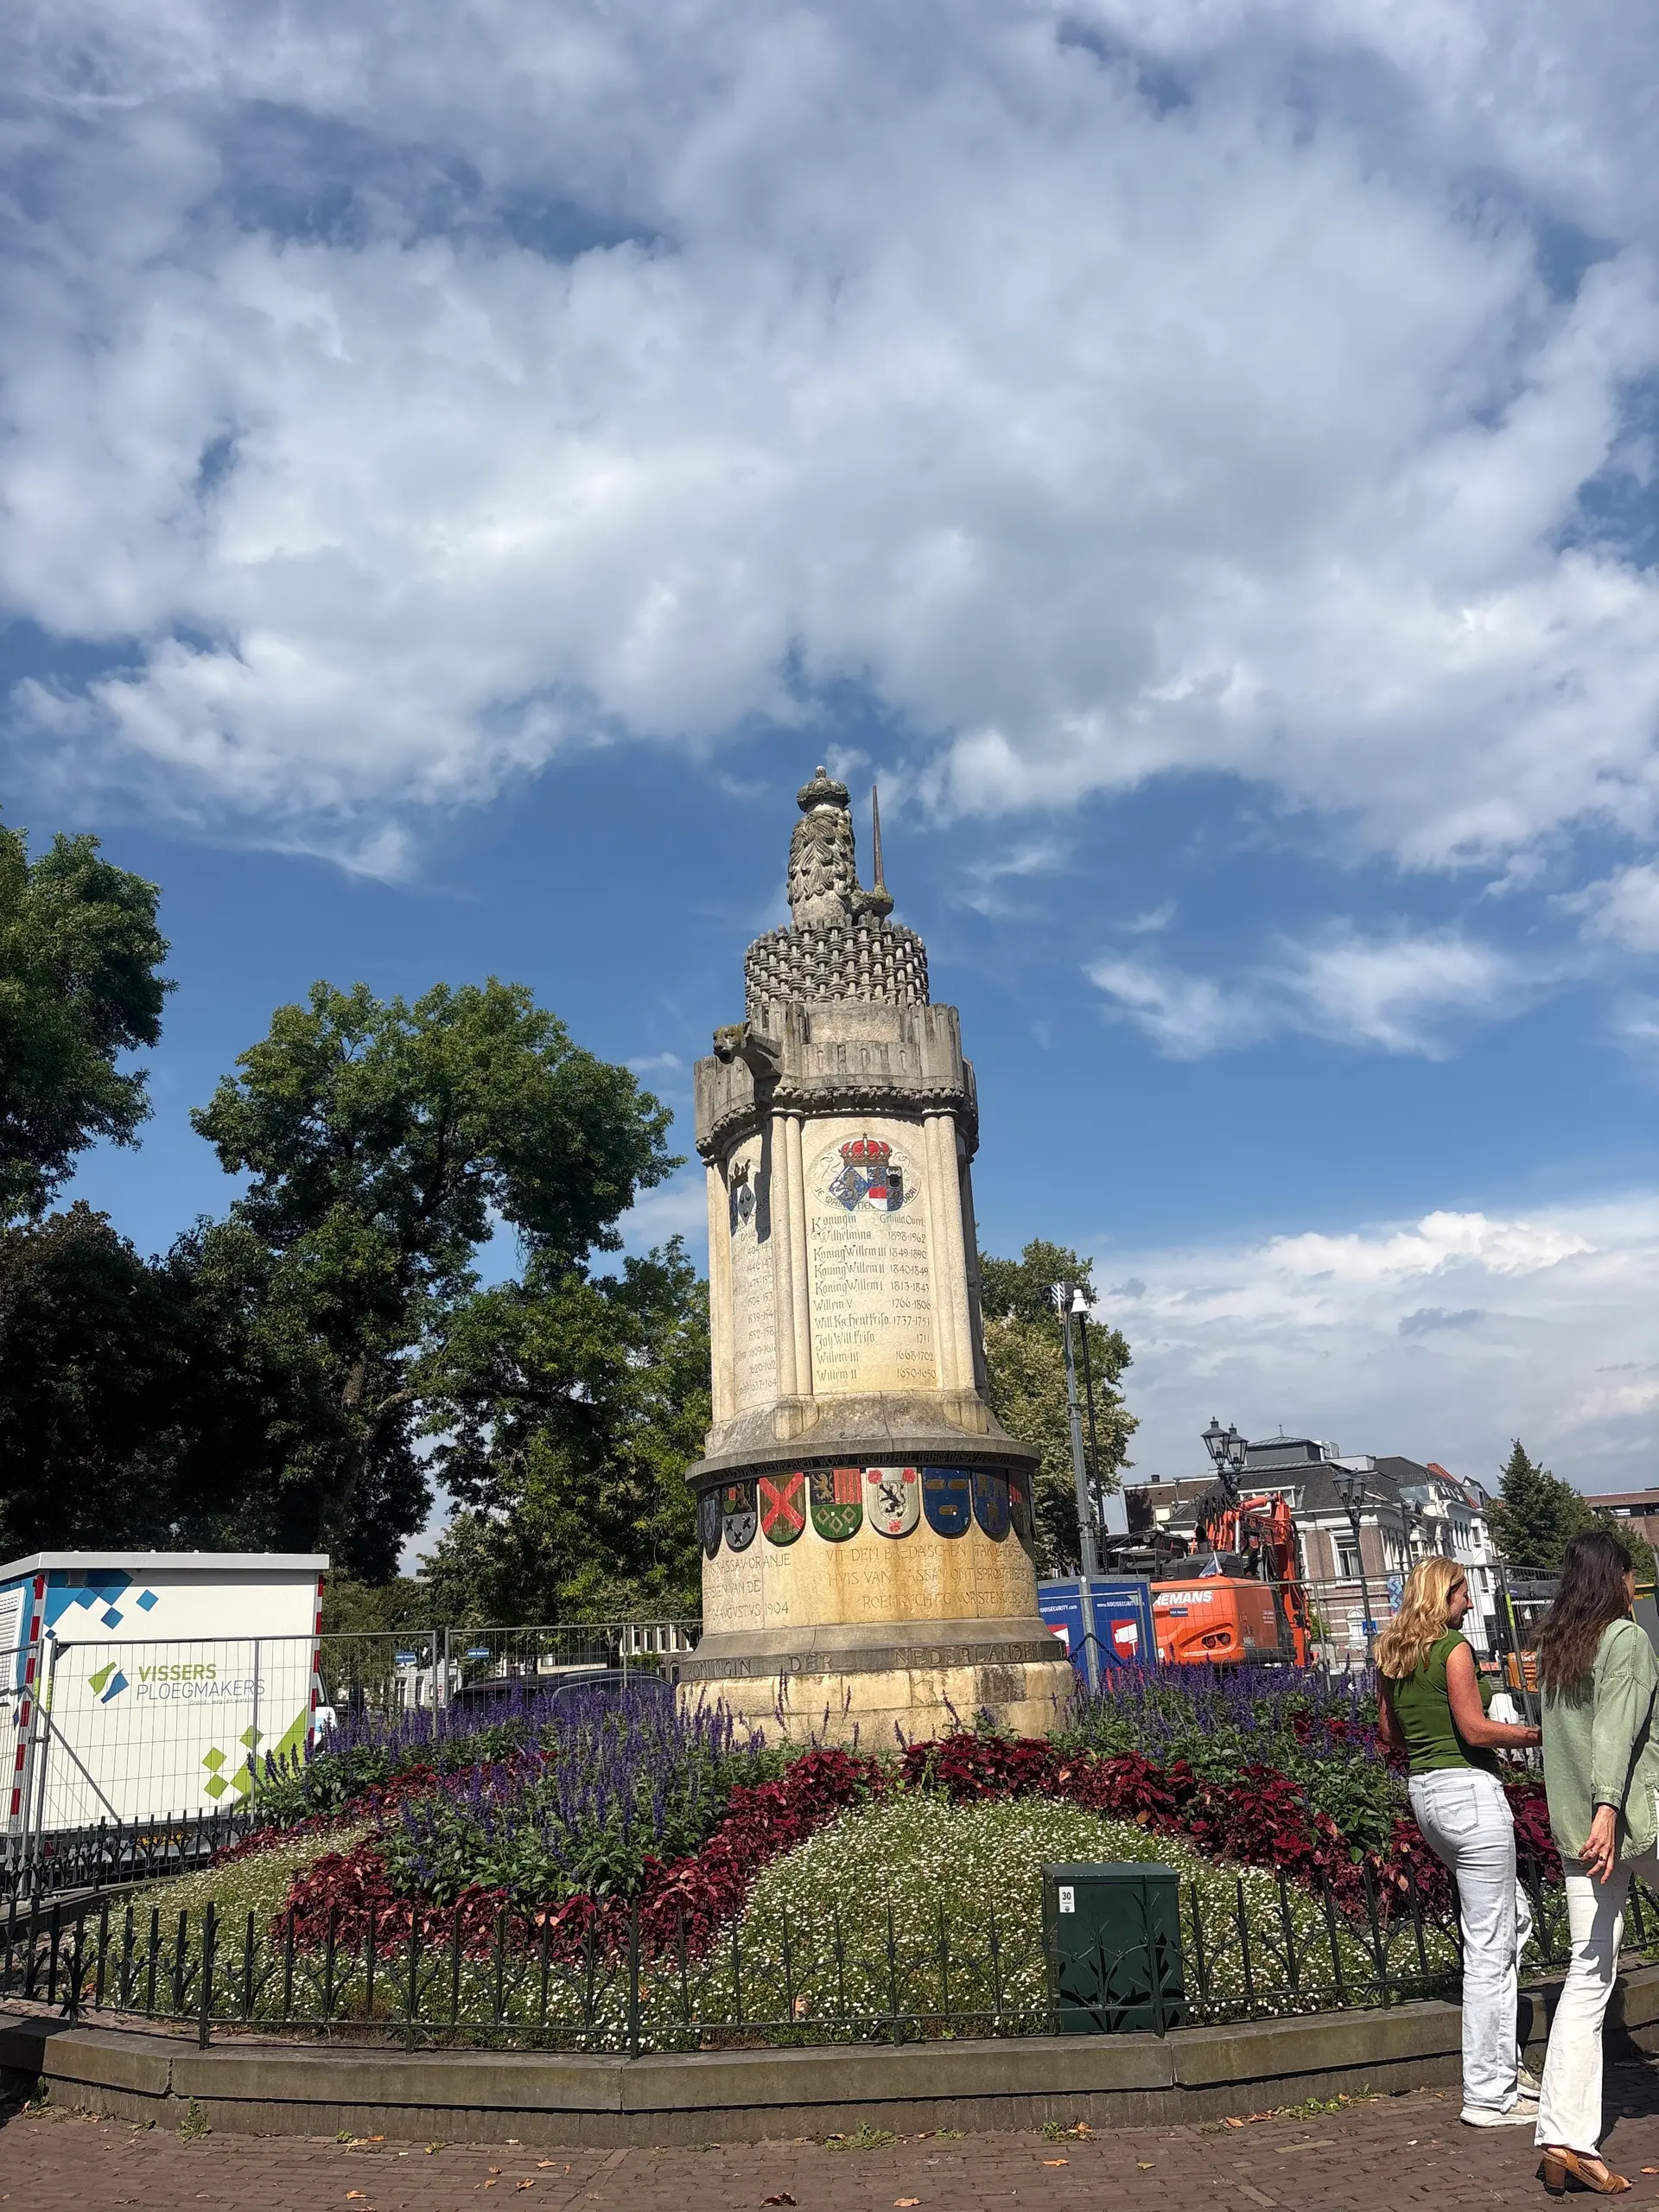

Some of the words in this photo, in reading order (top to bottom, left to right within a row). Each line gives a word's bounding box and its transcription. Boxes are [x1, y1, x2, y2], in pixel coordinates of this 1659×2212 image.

[810, 1229, 872, 1243] Wilhelmina
[888, 1230, 926, 1243] 1898-1962
[813, 1246, 846, 1262] Koning
[844, 1244, 876, 1257] Willem
[878, 1247, 887, 1257] III
[888, 1247, 927, 1260] 1849-1890
[814, 1262, 847, 1281] Koning
[845, 1262, 878, 1274] Willem
[890, 1264, 929, 1277] 1840-1849
[815, 1280, 848, 1296] Koning
[846, 1279, 879, 1292] Willem
[813, 1300, 844, 1312] Willem
[846, 1299, 853, 1309] V
[892, 1298, 931, 1311] 1766-1806
[893, 1314, 931, 1327] 1737-1751
[916, 1333, 931, 1344] 1711
[817, 1351, 847, 1364] Willem
[850, 1351, 859, 1363] III
[817, 1369, 848, 1382] Willem
[850, 1369, 857, 1380] II
[896, 1567, 948, 1583] ASSAV
[788, 1652, 834, 1674] DER
[893, 1641, 1041, 1667] NEDERLANDEN
[138, 1663, 217, 1682] VISSERS
[137, 1679, 265, 1700] PLOEGMAKERS
[1062, 1891, 1071, 1901] 30
